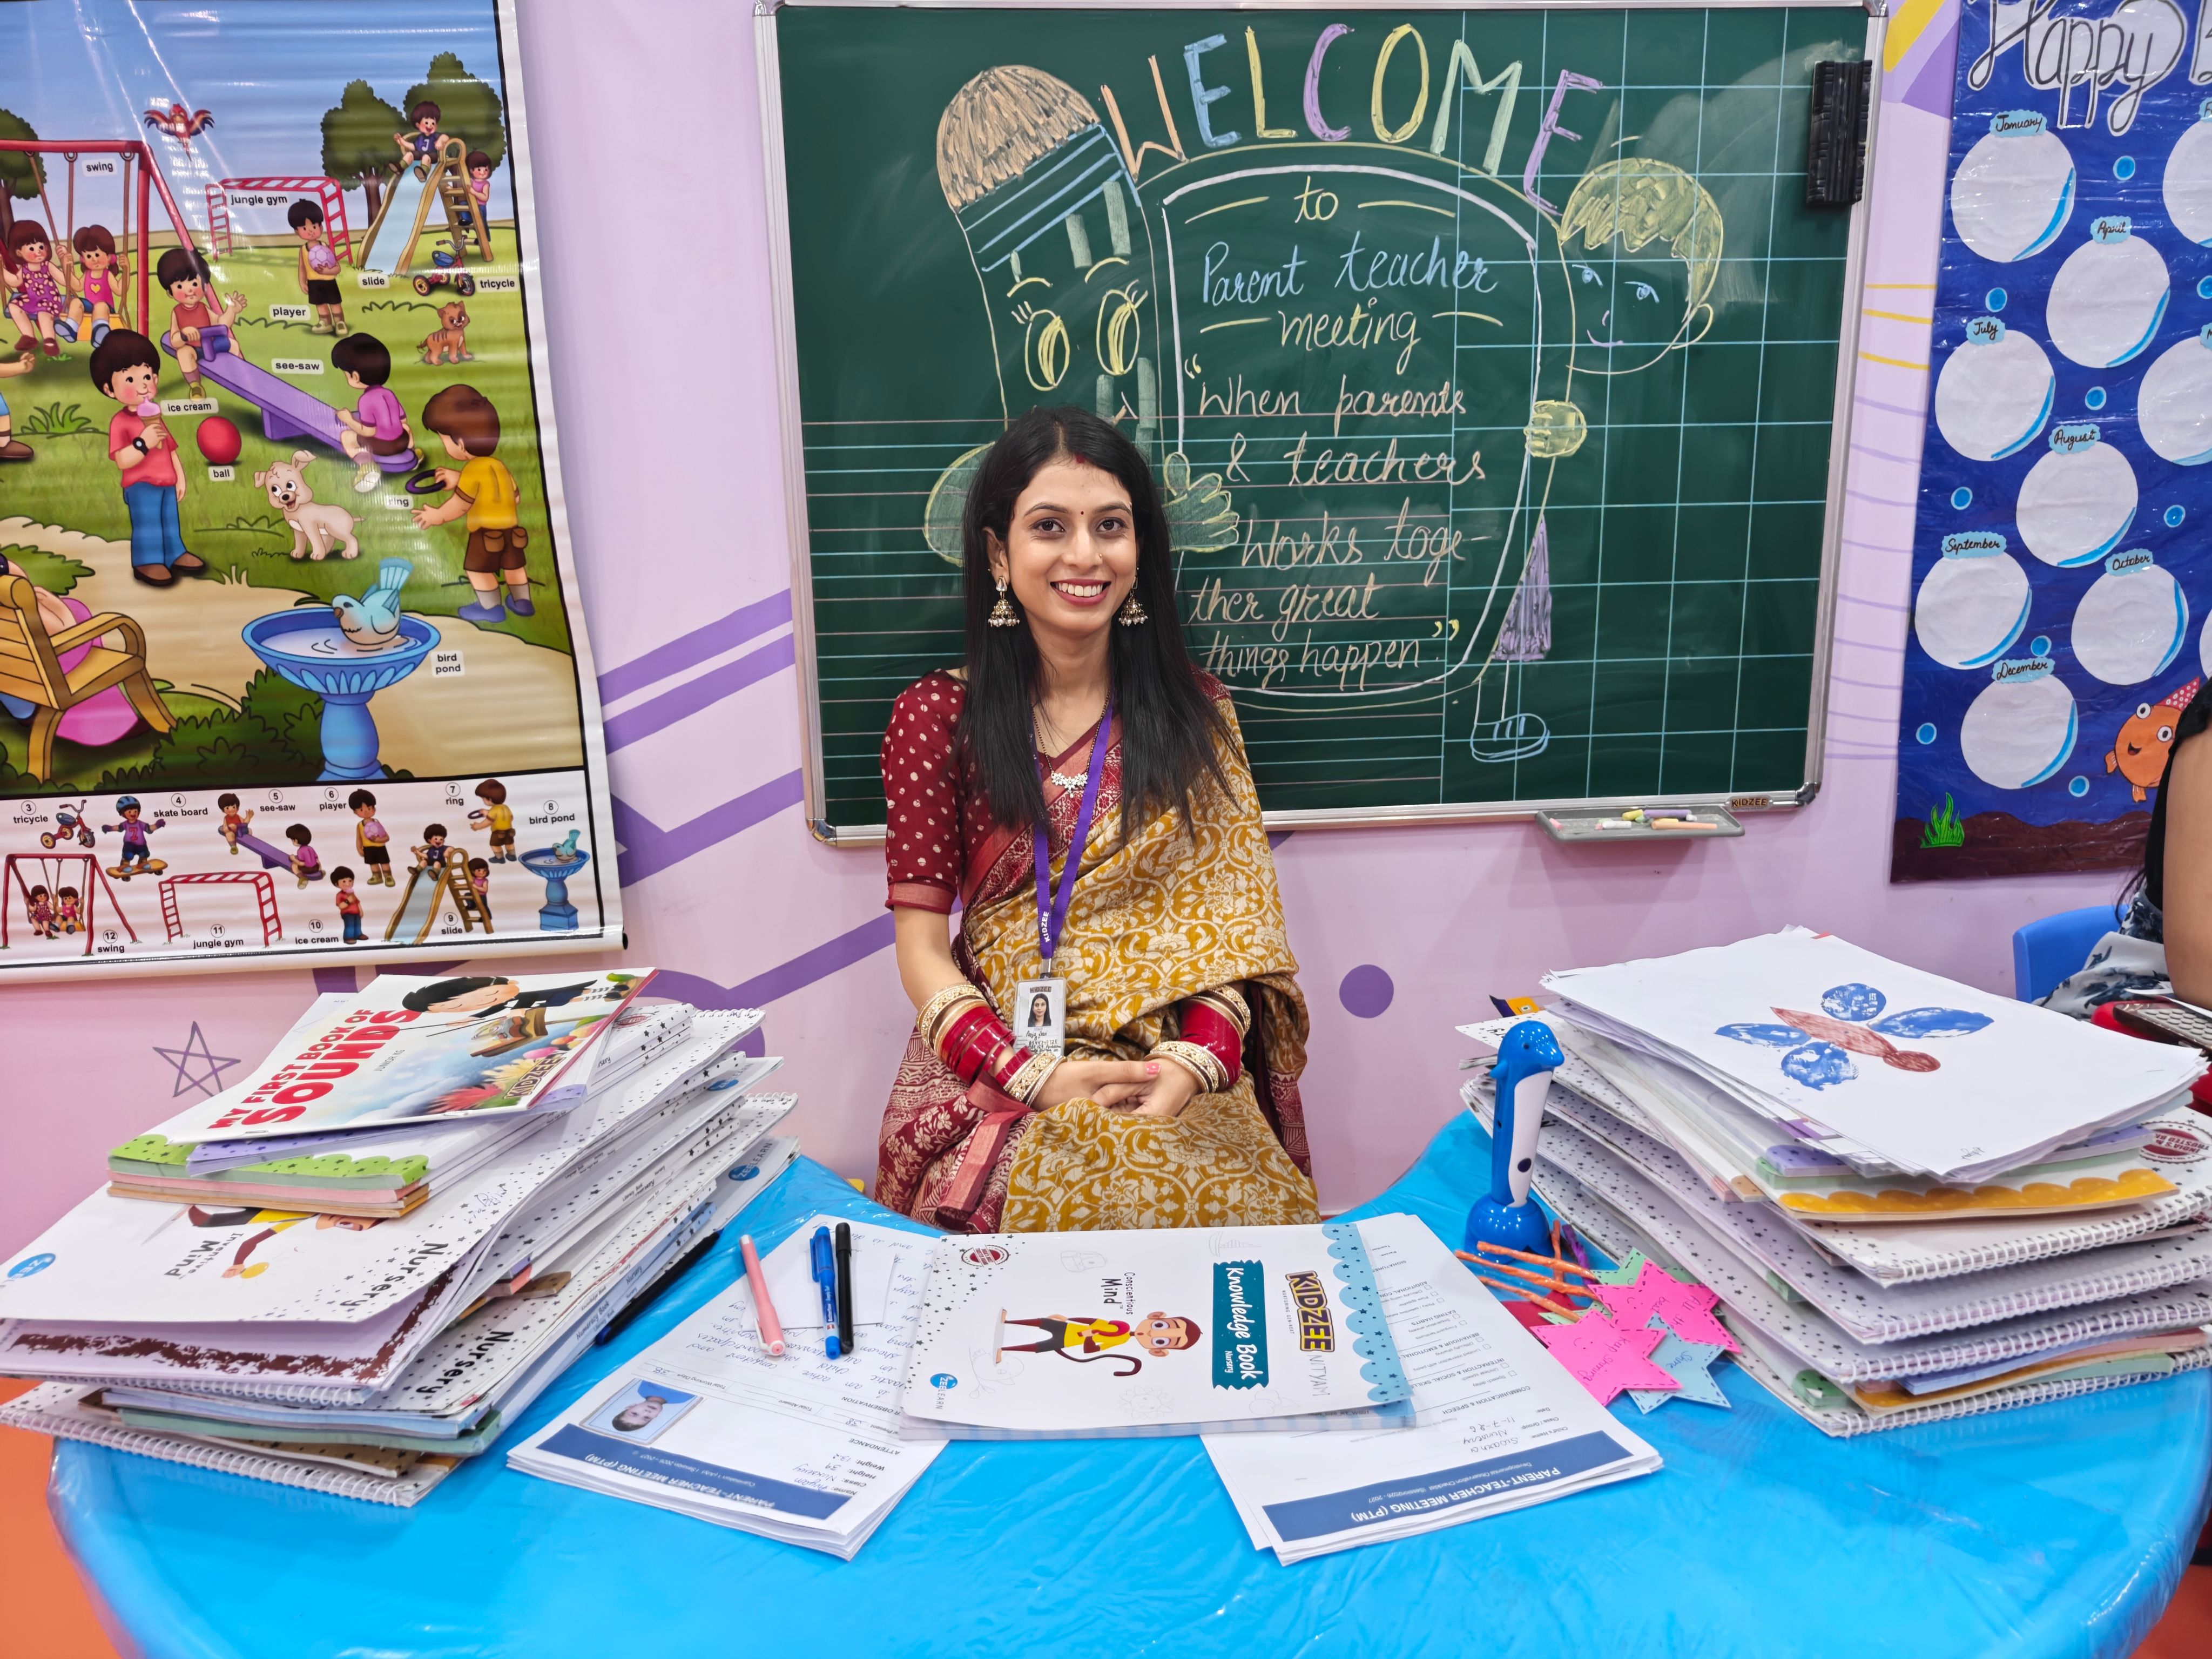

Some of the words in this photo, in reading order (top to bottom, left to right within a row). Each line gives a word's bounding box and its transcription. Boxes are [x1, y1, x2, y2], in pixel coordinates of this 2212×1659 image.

[1100, 23, 1604, 216] WELCOME
[1995, 114, 2043, 133] January
[86, 161, 114, 174] swing
[231, 194, 262, 206] jungle
[265, 195, 288, 205] gym
[1294, 176, 1339, 222] to
[2097, 220, 2127, 240] April
[1203, 241, 1308, 306] Parent
[1335, 230, 1499, 293] teacher
[362, 275, 385, 286] slide
[480, 278, 516, 290] tricycle
[272, 306, 307, 319] player
[1278, 297, 1421, 375] meeting
[1973, 322, 1999, 340] July
[275, 360, 320, 372] see-saw
[167, 402, 180, 412] ice
[183, 401, 211, 412] cream
[1333, 375, 1467, 437] parents
[2054, 429, 2096, 450] August
[1284, 431, 1486, 487] teachers
[213, 468, 231, 479] ball
[1945, 537, 2000, 555] September
[2112, 555, 2150, 571] October
[1188, 577, 1264, 625] ther
[1272, 571, 1384, 643] great
[437, 653, 457, 663] bird
[1199, 630, 1291, 691] things
[435, 664, 461, 674] pond
[1997, 662, 2048, 680] December
[273, 792, 279, 800] 5
[328, 790, 335, 798] 6
[25, 804, 31, 812] 3
[260, 804, 296, 812] see-saw
[319, 801, 347, 811] player
[446, 797, 464, 806] ring
[548, 803, 554, 811] 8
[1731, 798, 1768, 808] KIDZEE
[153, 808, 179, 818] skate
[180, 807, 208, 817] board
[529, 815, 548, 824] bird
[551, 814, 575, 824] pond
[13, 815, 49, 824] tricycle
[448, 914, 454, 922] 9
[213, 927, 223, 935] 11
[311, 921, 321, 929] 10
[441, 926, 463, 935] slide
[1041, 911, 1050, 942] KIDZEE
[105, 932, 116, 940] 12
[295, 936, 308, 945] ice
[311, 936, 339, 944] cream
[97, 944, 125, 953] swing
[193, 939, 222, 949] jungle
[224, 938, 244, 948] gym
[241, 1009, 423, 1125] SOUNDS
[597, 1056, 611, 1068] rsery
[206, 1108, 253, 1129] MY
[240, 1063, 308, 1103] FIRST
[295, 1026, 357, 1060] BOOK
[344, 1009, 375, 1023] OF
[164, 1240, 221, 1277] Mind
[340, 1243, 449, 1306] Nursery
[599, 1300, 610, 1315] Book
[626, 1265, 643, 1284] Nursery
[1101, 1278, 1123, 1304] Mind
[1124, 1272, 1136, 1314] Conscientious
[1225, 1267, 1255, 1339] Knowledge
[1286, 1271, 1335, 1352] KIDZEE
[416, 1331, 514, 1393] Nursery
[1224, 1351, 1233, 1373] Nursery
[1236, 1344, 1264, 1380] Book
[848, 1438, 901, 1455] ATTENDANCE
[855, 1460, 885, 1471] Weight:
[847, 1469, 876, 1479] Height:
[841, 1478, 866, 1487] Class:
[1447, 1467, 1561, 1499] PARENT-TEACHER
[1390, 1494, 1448, 1513] MEETING
[1350, 1505, 1389, 1522] (PTM)
